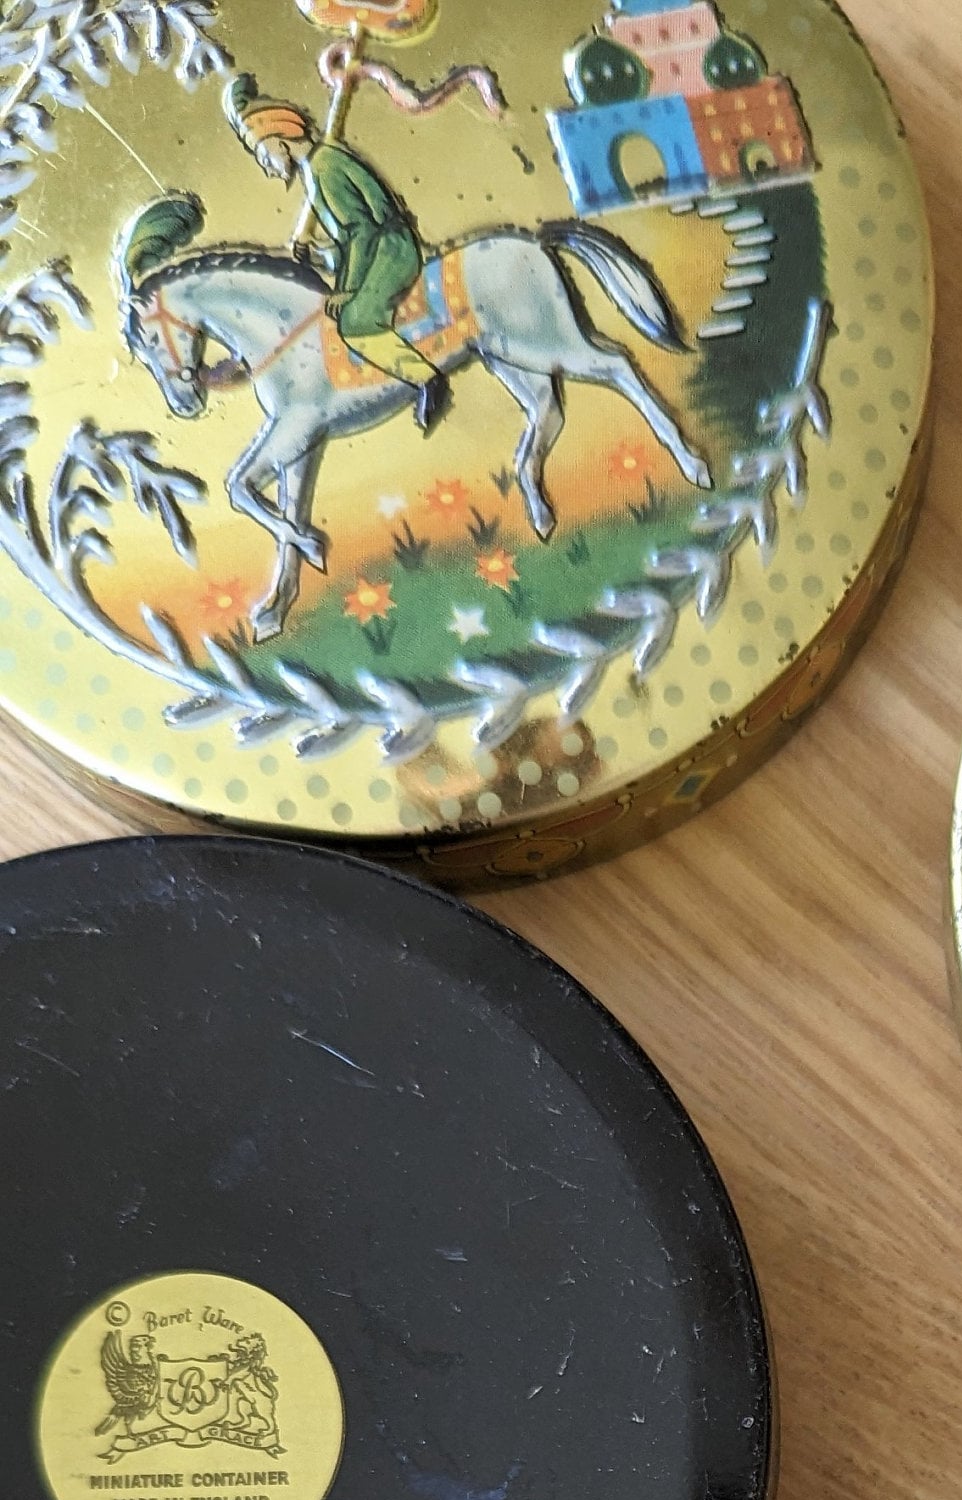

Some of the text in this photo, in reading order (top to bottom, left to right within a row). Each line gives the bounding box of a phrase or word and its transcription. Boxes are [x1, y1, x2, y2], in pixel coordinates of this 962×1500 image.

[143, 1308, 193, 1332] Baret
[202, 1305, 245, 1334] Ware
[136, 1427, 262, 1448] ART GRACE
[89, 1471, 290, 1489] MINIATURE CONTAINER
